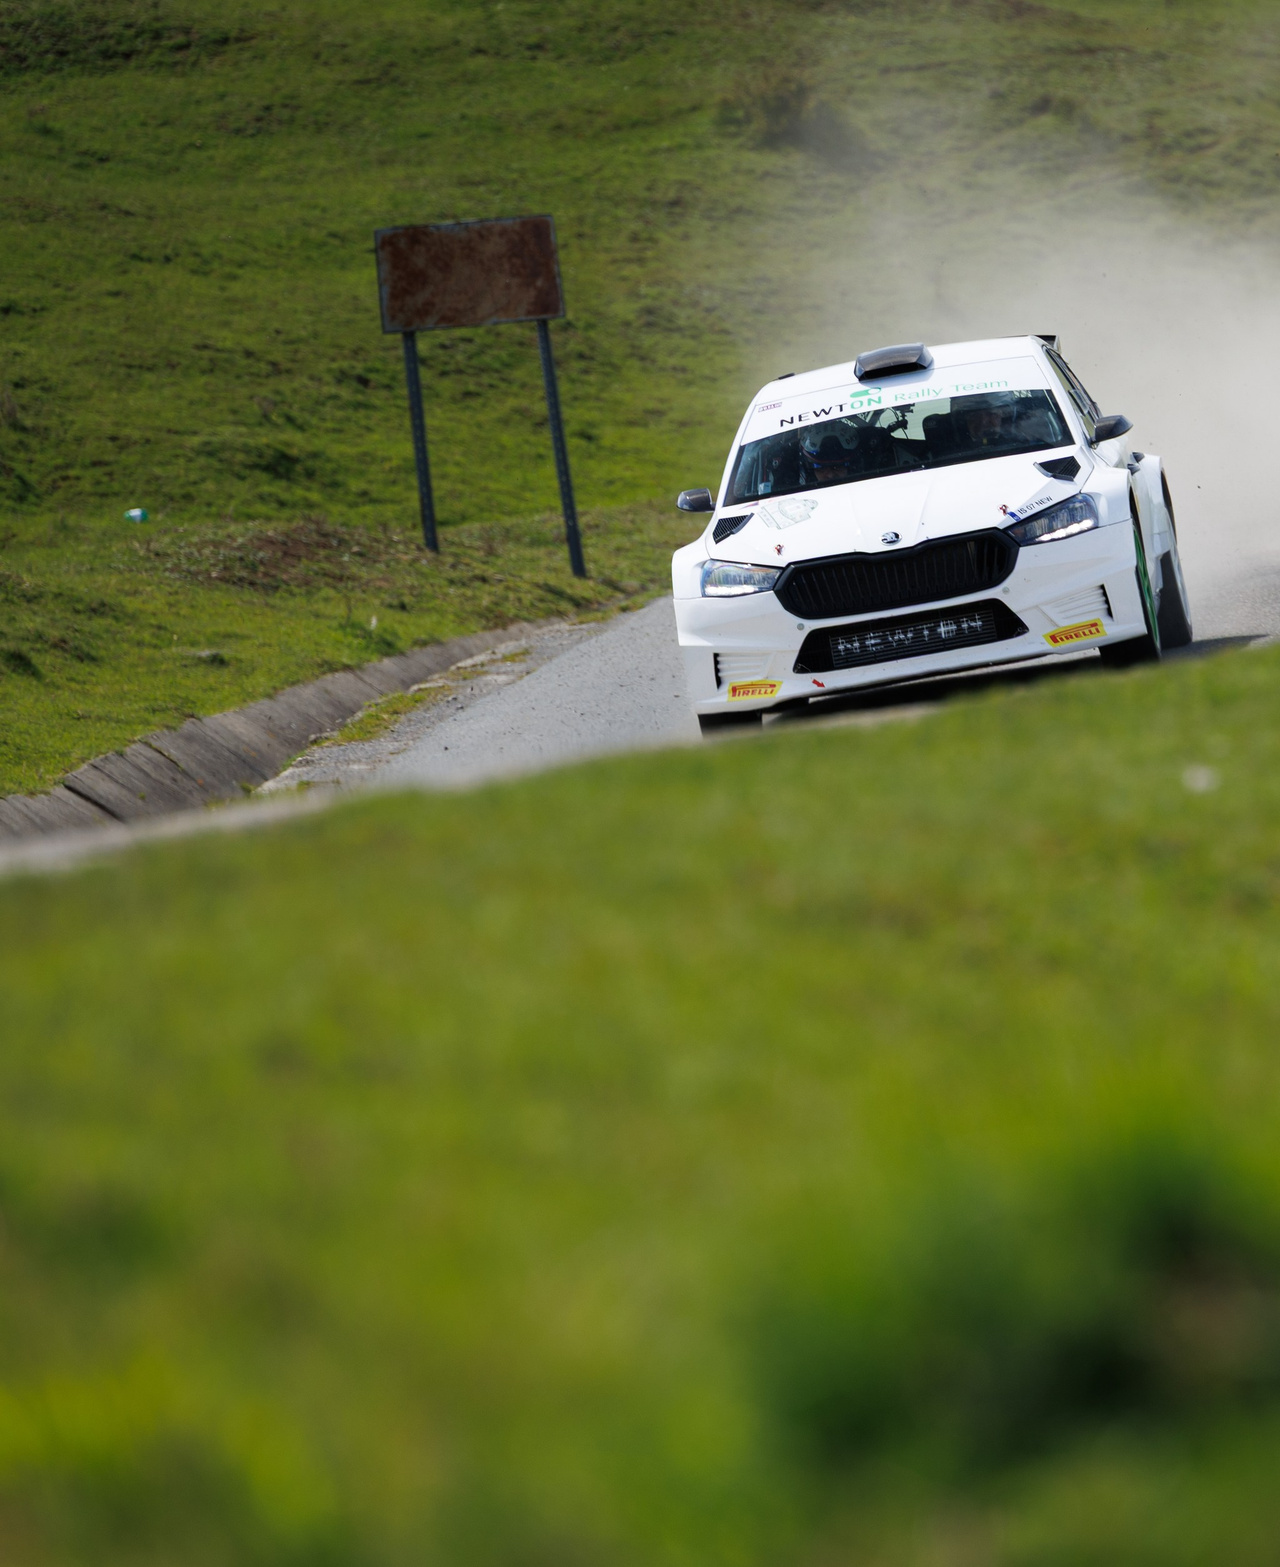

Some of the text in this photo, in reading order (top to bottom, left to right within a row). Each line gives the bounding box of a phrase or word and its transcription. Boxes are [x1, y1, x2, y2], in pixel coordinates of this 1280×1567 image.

[780, 396, 882, 427] NEWTON
[894, 387, 944, 402] Rally
[954, 379, 1009, 393] Team
[1034, 495, 1053, 507] NEW
[837, 613, 983, 656] NEWTON
[1049, 622, 1101, 644] PIRELLI
[731, 683, 777, 698] PIRELLI
